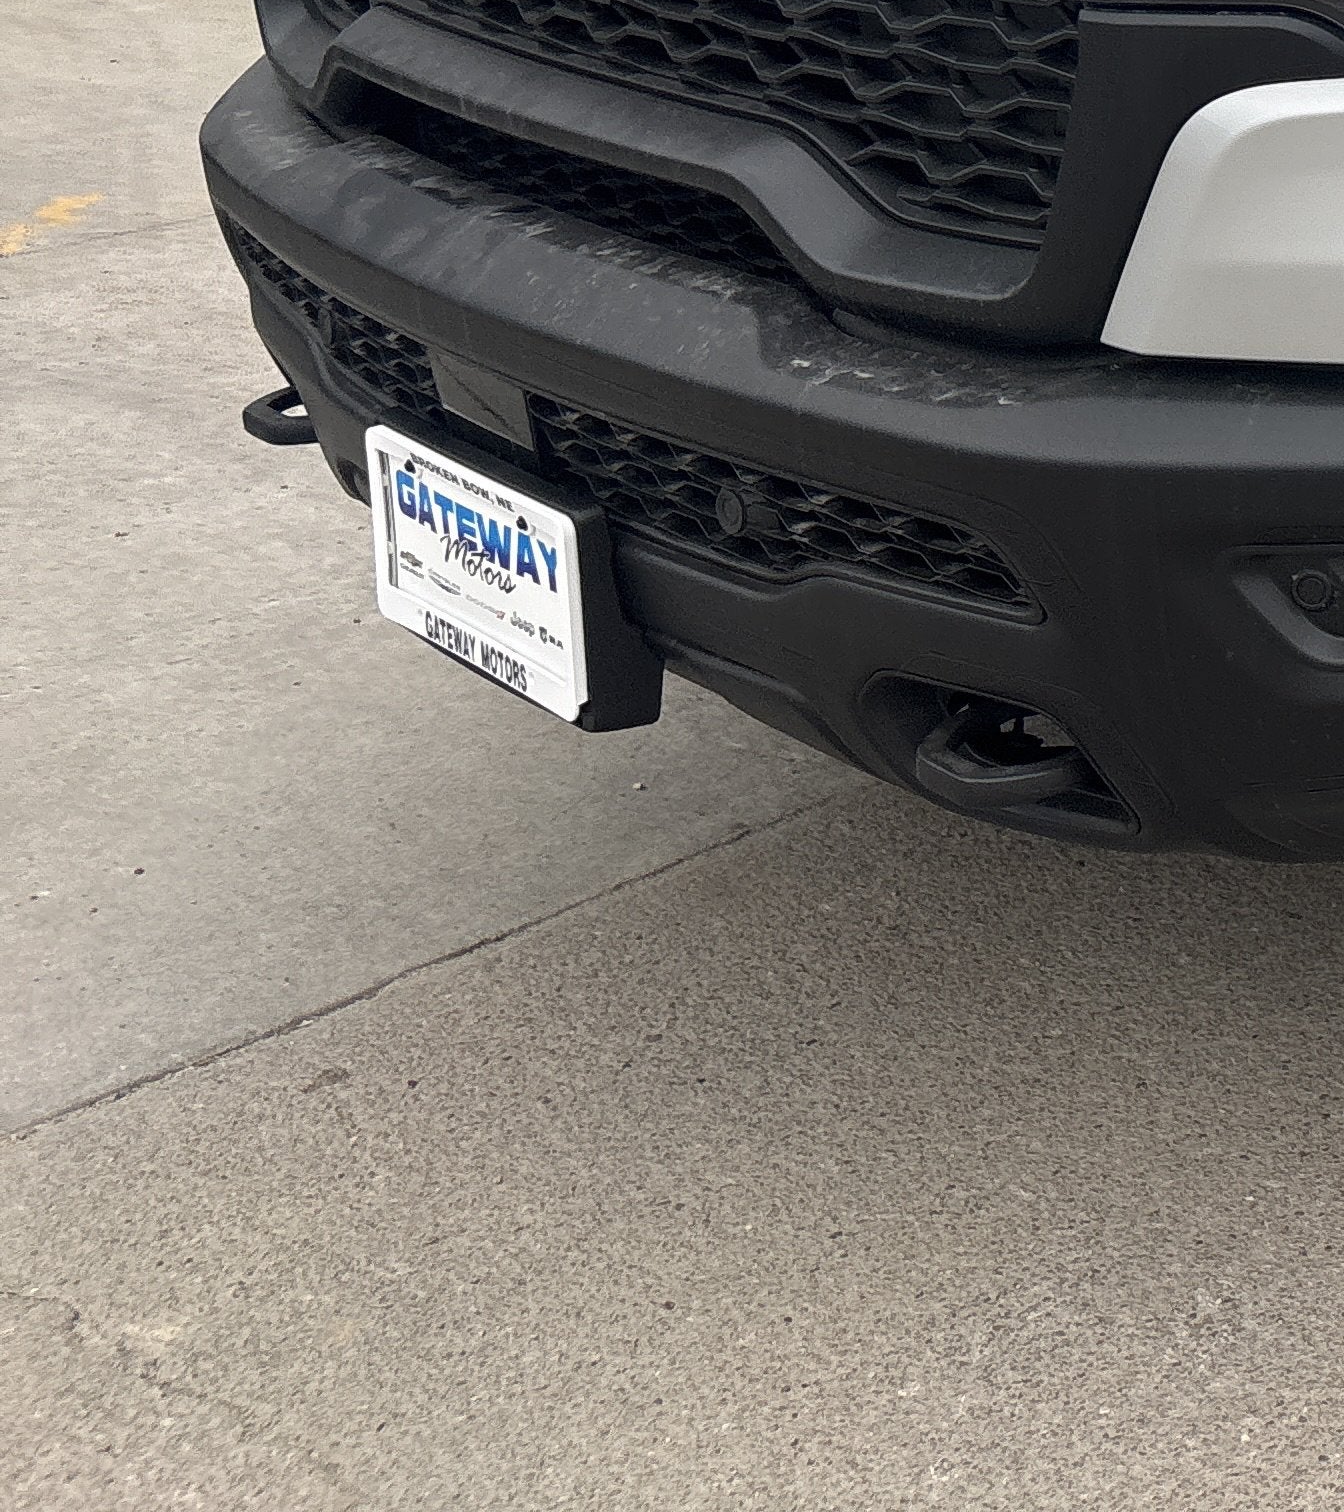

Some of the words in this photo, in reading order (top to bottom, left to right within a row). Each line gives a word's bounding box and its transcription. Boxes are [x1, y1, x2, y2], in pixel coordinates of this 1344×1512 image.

[396, 469, 558, 593] GATEWAY
[440, 535, 516, 594] Motors
[424, 610, 476, 662] GATEWAY
[480, 640, 528, 692] MOTORS
